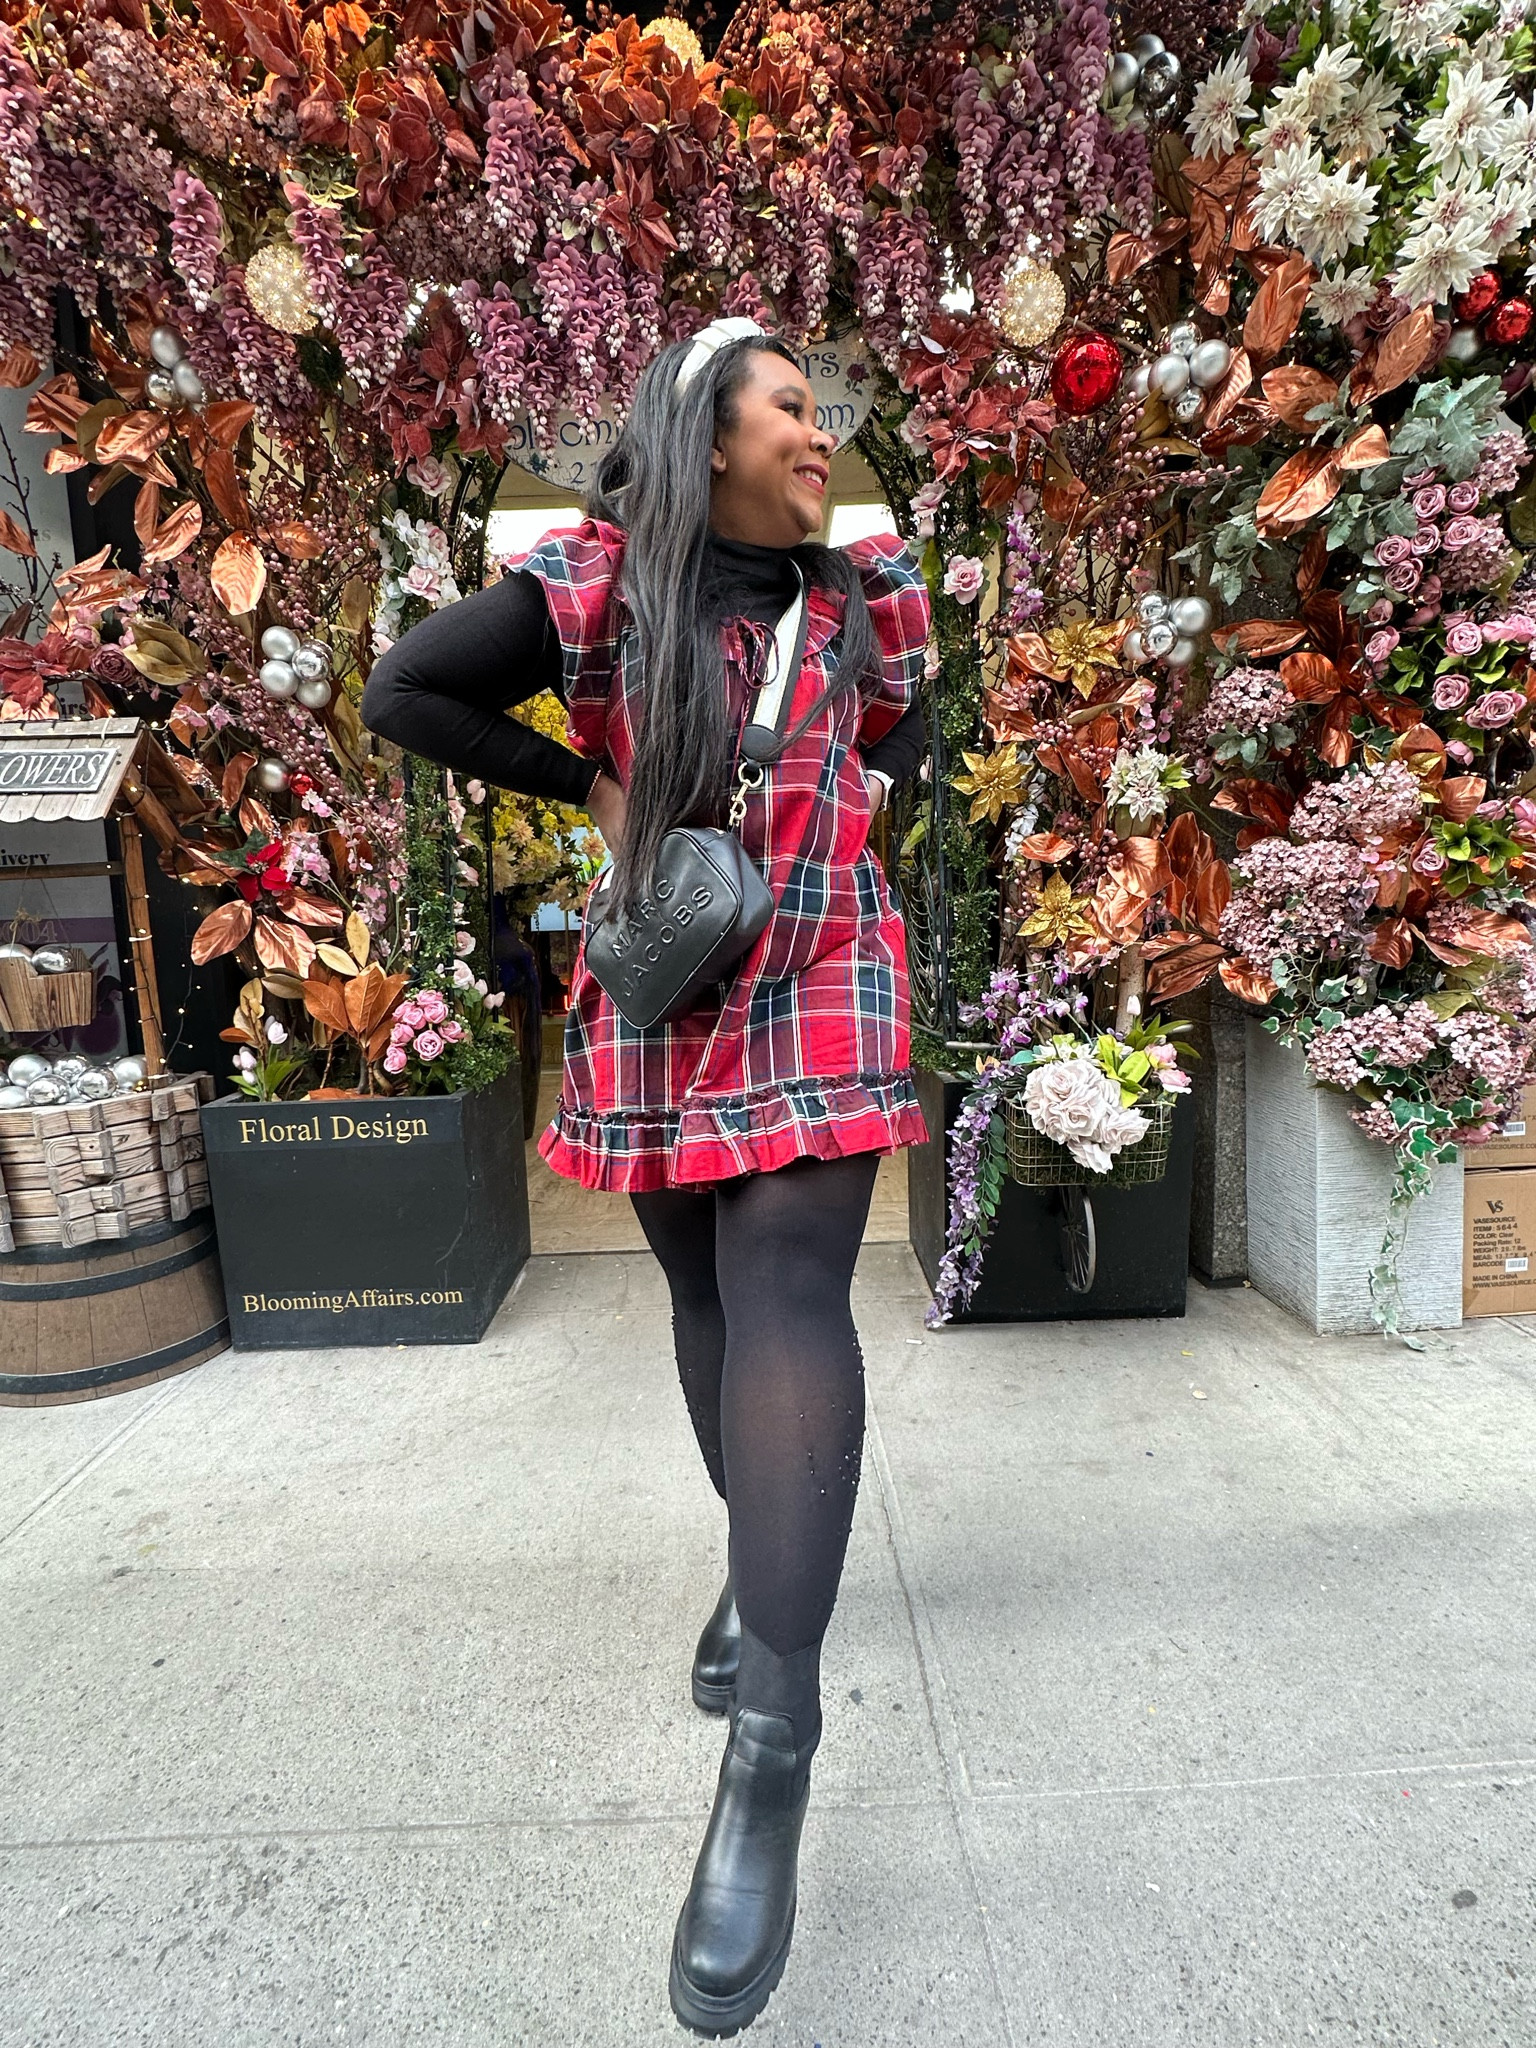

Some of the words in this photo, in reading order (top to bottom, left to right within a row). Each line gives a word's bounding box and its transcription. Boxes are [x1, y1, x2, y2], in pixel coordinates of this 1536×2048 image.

[611, 879, 674, 960] MARC
[622, 885, 713, 997] JACOBS
[238, 1116, 322, 1143] Floral
[329, 1113, 429, 1143] Design
[1473, 1216, 1516, 1224] VASESOURCE
[1486, 1200, 1504, 1214] VS
[242, 1288, 464, 1313] BloomingAffairs.com
